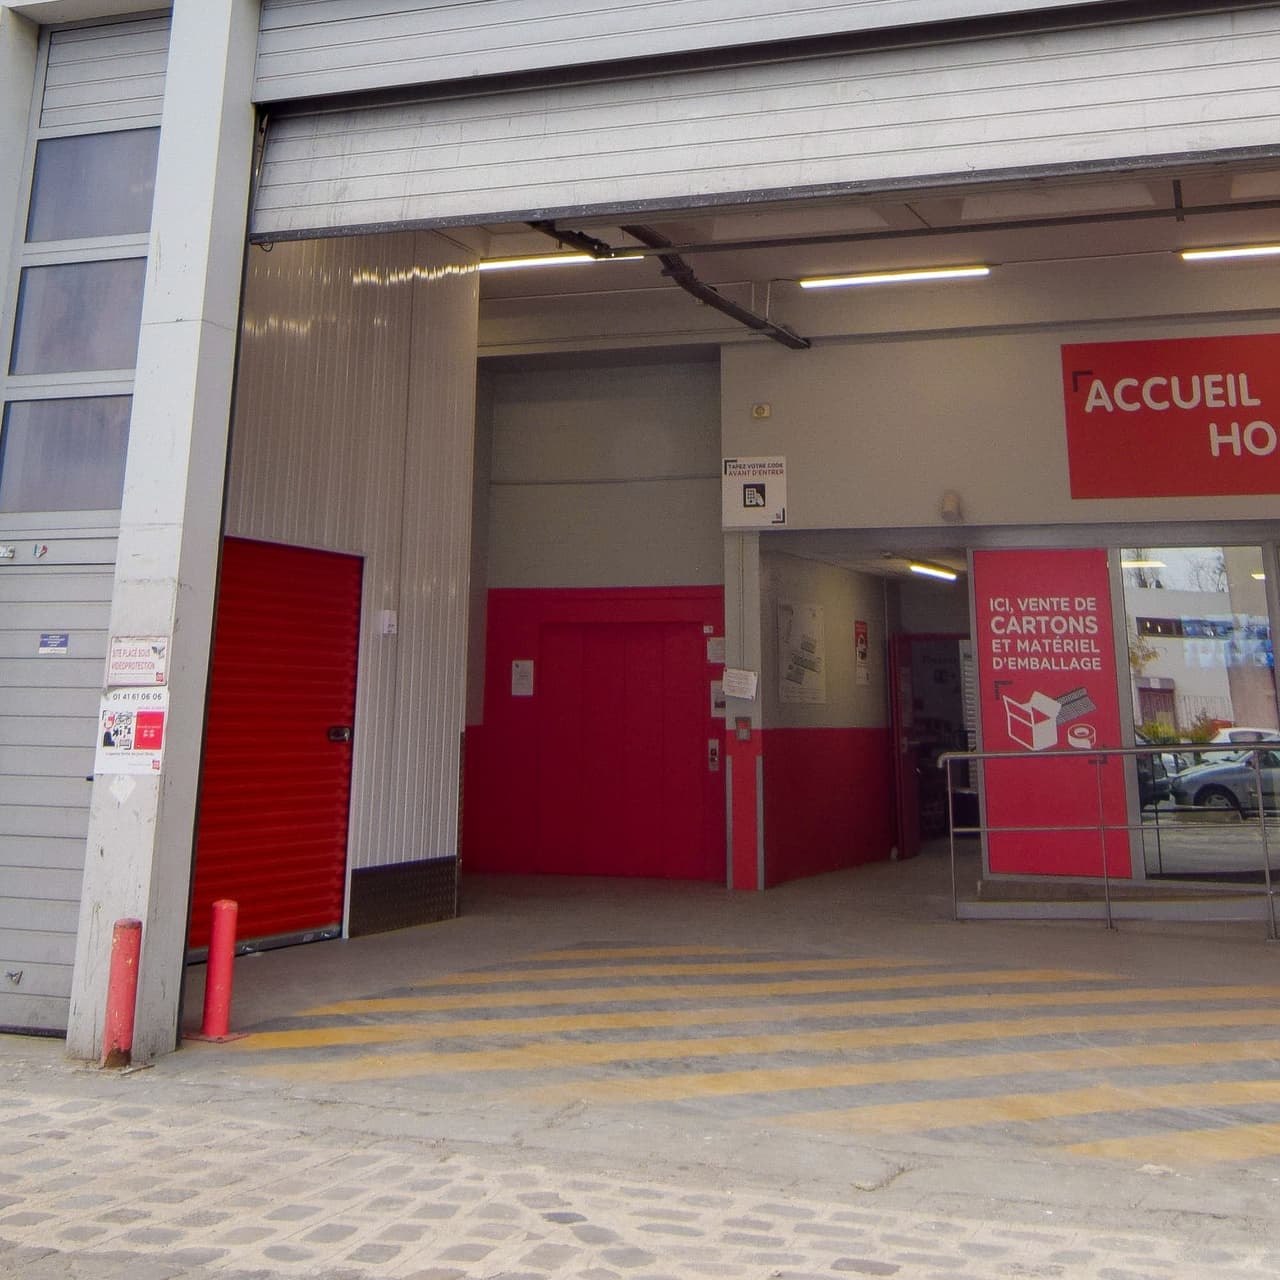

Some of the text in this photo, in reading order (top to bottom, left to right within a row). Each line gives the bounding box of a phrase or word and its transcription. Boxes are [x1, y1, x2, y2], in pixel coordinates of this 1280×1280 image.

[1084, 372, 1261, 414] ACCUEIL
[989, 597, 1097, 613] ICI, VENTE DE
[990, 615, 1098, 634] CARTONS
[992, 636, 1101, 653] ET MATÉRIEL
[992, 657, 1102, 670] D'EMBALLAGE
